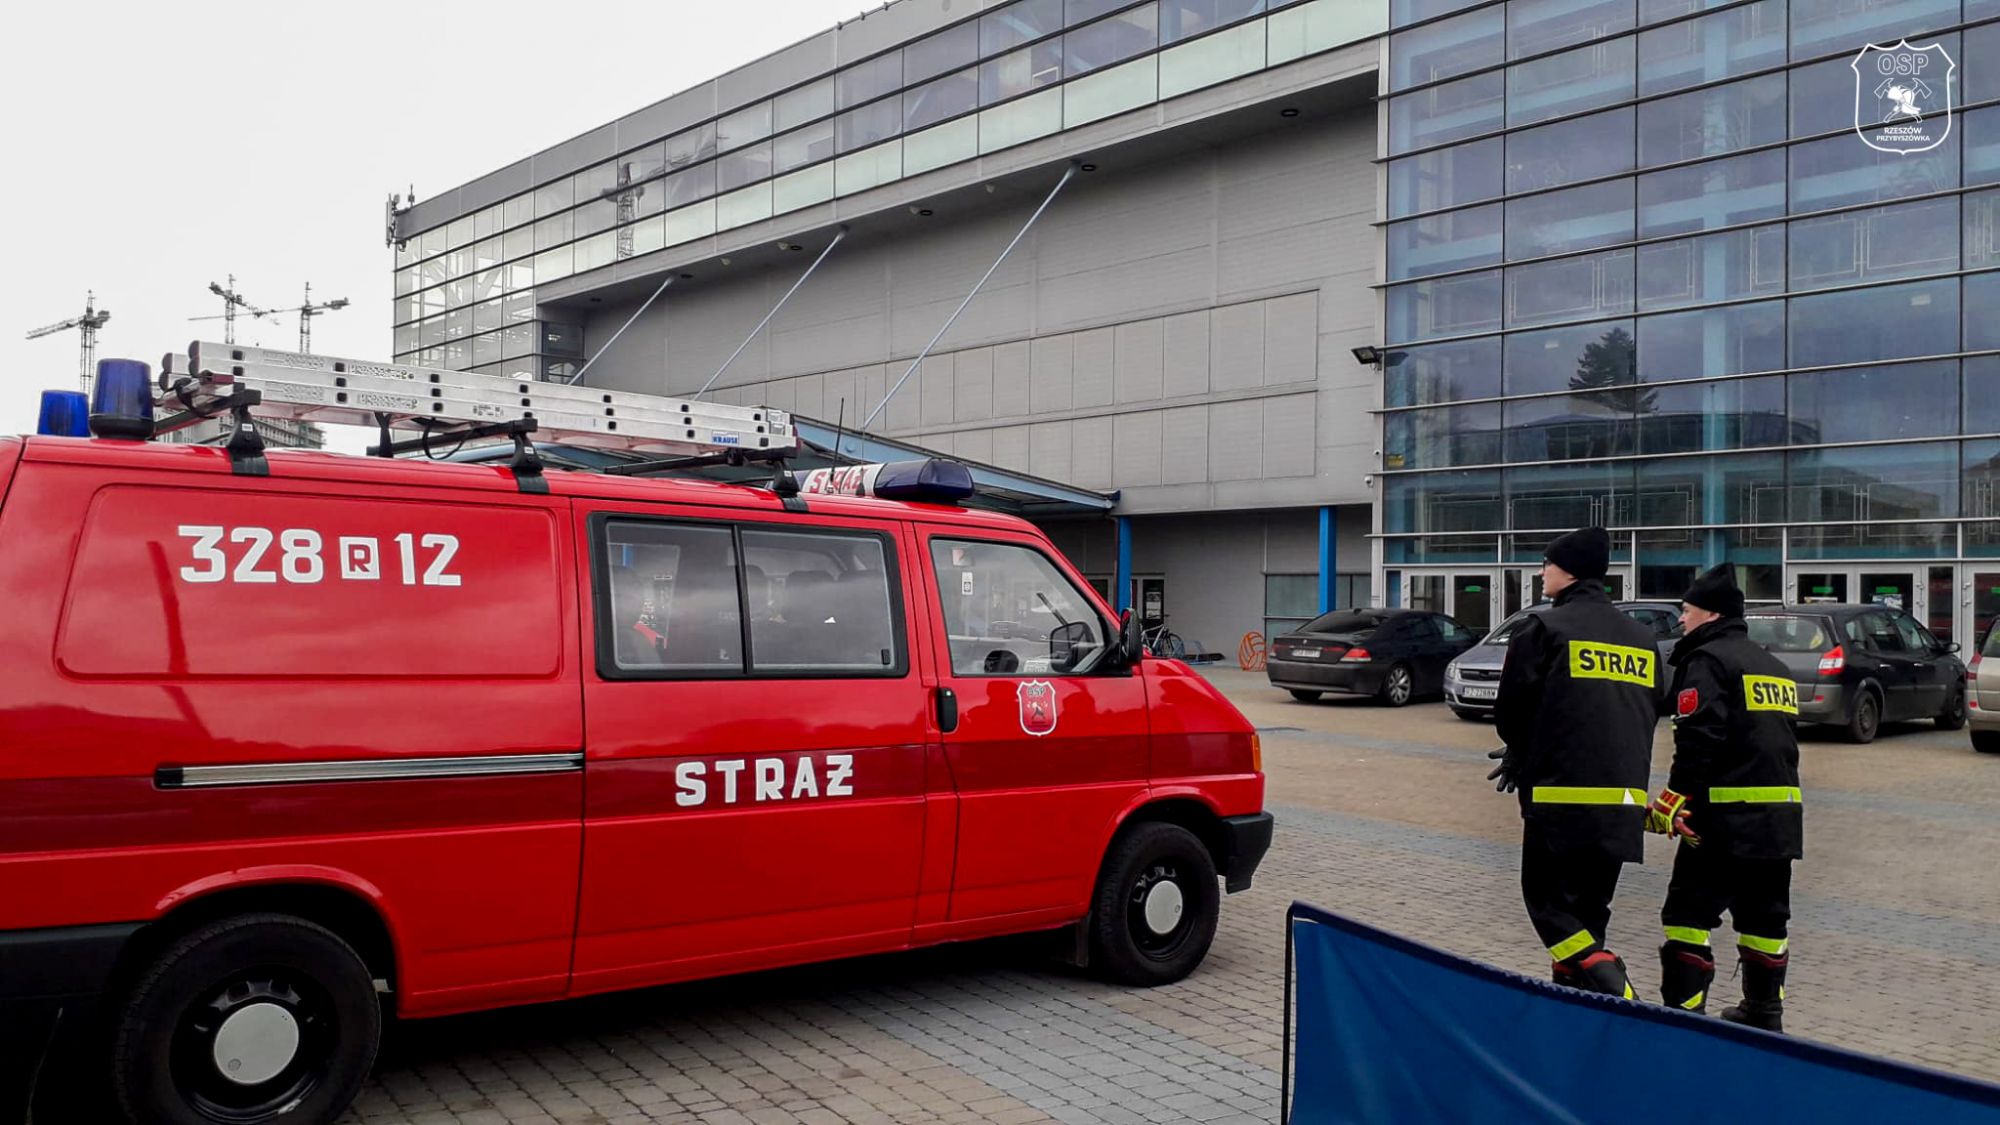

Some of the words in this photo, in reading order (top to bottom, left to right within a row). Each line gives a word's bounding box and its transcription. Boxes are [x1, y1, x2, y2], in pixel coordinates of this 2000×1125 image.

[178, 525, 324, 583] 328
[347, 542, 375, 575] R
[394, 533, 461, 586] 12
